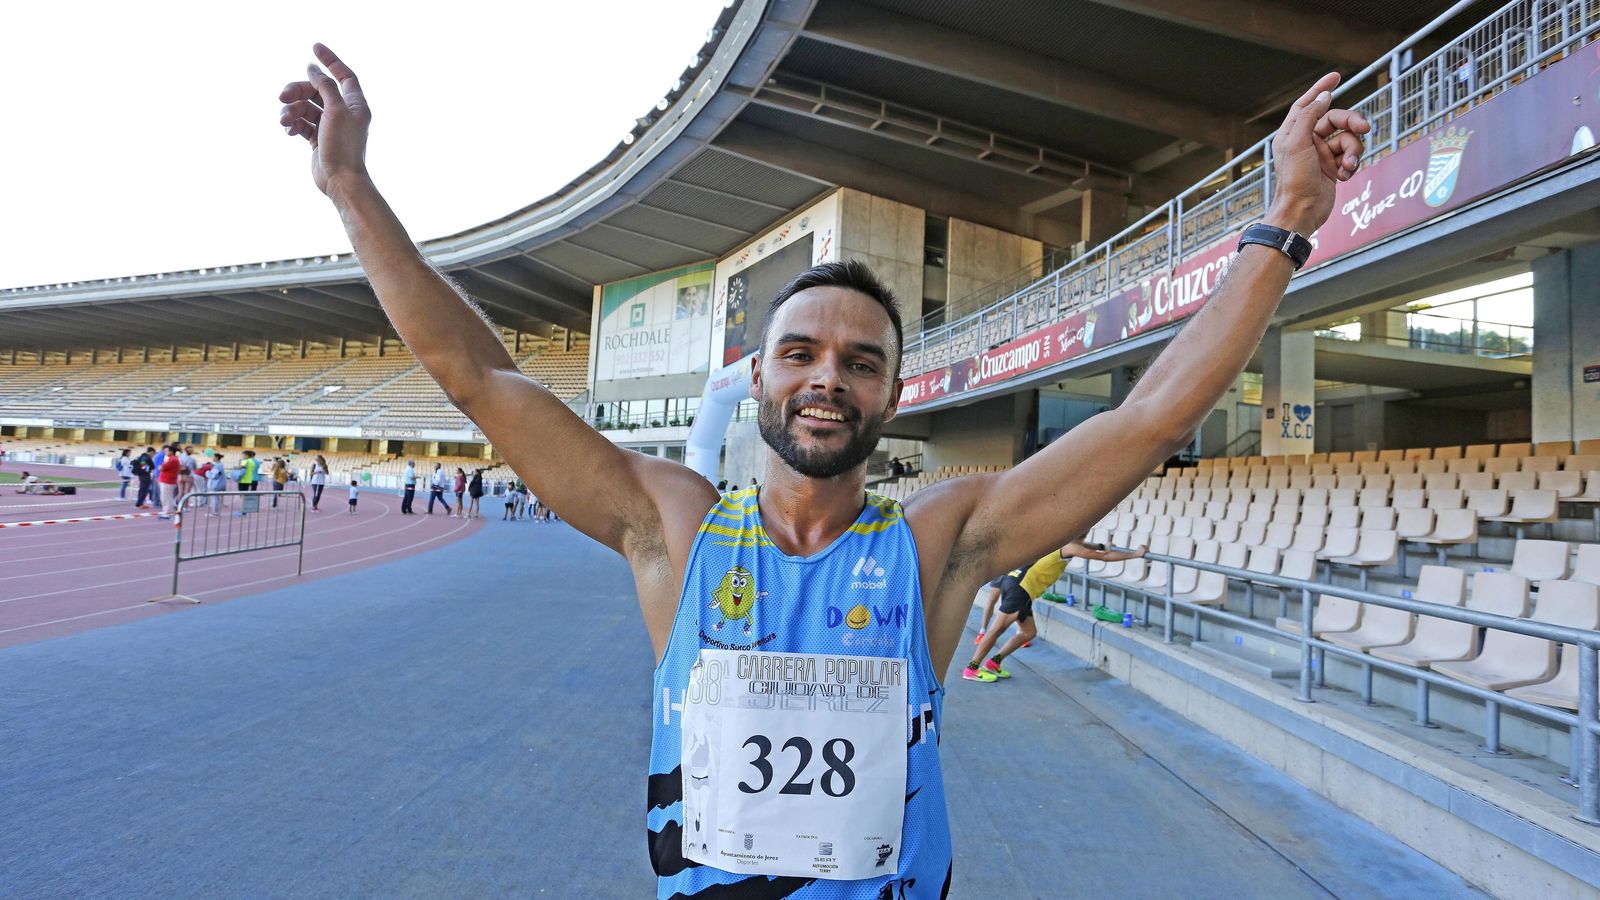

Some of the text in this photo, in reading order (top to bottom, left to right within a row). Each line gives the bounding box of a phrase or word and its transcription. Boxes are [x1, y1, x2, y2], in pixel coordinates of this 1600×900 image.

[1399, 169, 1424, 199] CD
[605, 328, 671, 351] ROCHDALE
[981, 340, 1040, 380] Cruzcampo
[698, 630, 729, 650] Deportivo
[730, 643, 751, 651] Surco
[737, 654, 817, 682] CARRERA
[824, 658, 902, 686] POPULAR
[748, 681, 889, 700] CIUDAD DE
[737, 734, 856, 798] 328
[720, 850, 756, 860] Ayuntamiento
